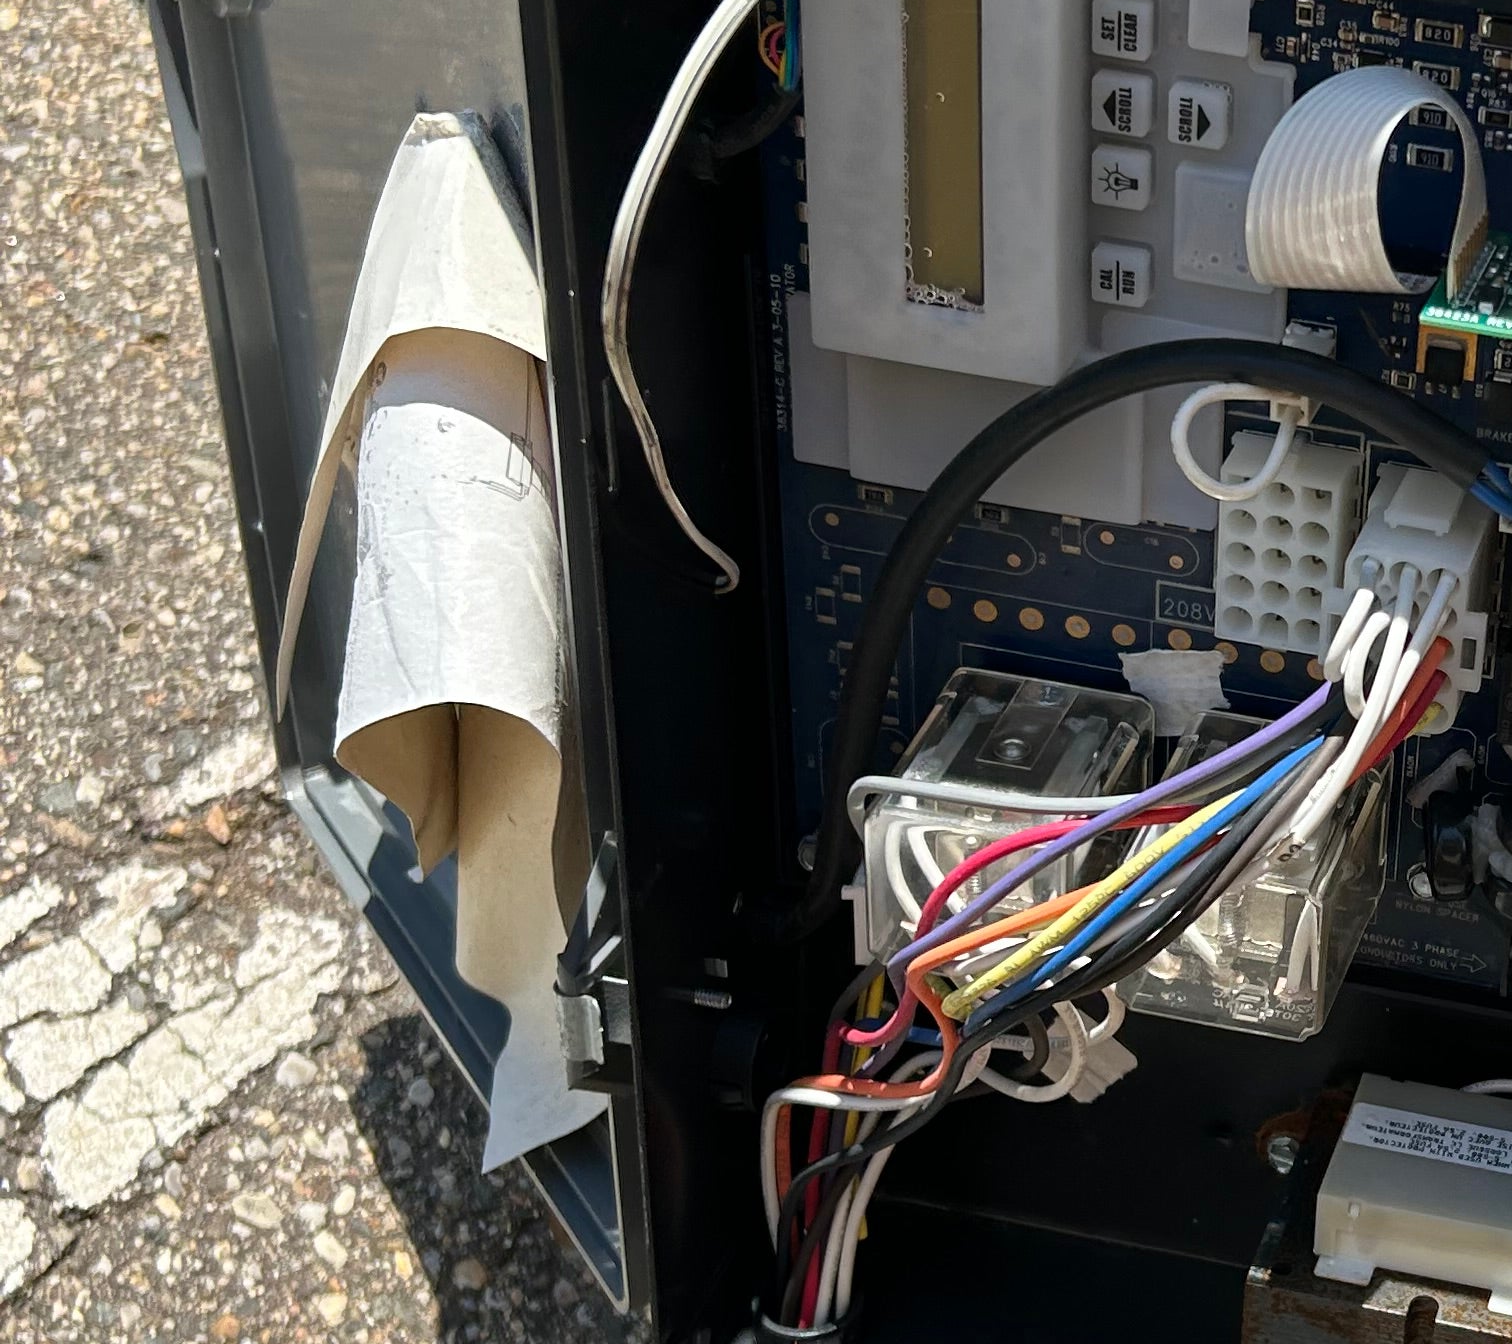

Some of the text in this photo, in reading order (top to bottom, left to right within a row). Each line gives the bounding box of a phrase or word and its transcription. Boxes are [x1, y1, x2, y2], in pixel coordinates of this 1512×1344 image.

[1101, 17, 1115, 40] SET
[1124, 12, 1138, 52] CLEAR
[1424, 28, 1452, 41] 820
[1118, 87, 1133, 133] SCROLL
[1179, 96, 1193, 142] SCROLL
[1100, 268, 1113, 290] CAL
[1123, 269, 1136, 295] RUN
[769, 274, 784, 332] 3-05-10
[773, 336, 784, 346] A
[773, 349, 786, 373] REV
[1425, 941, 1460, 957] PHASE
